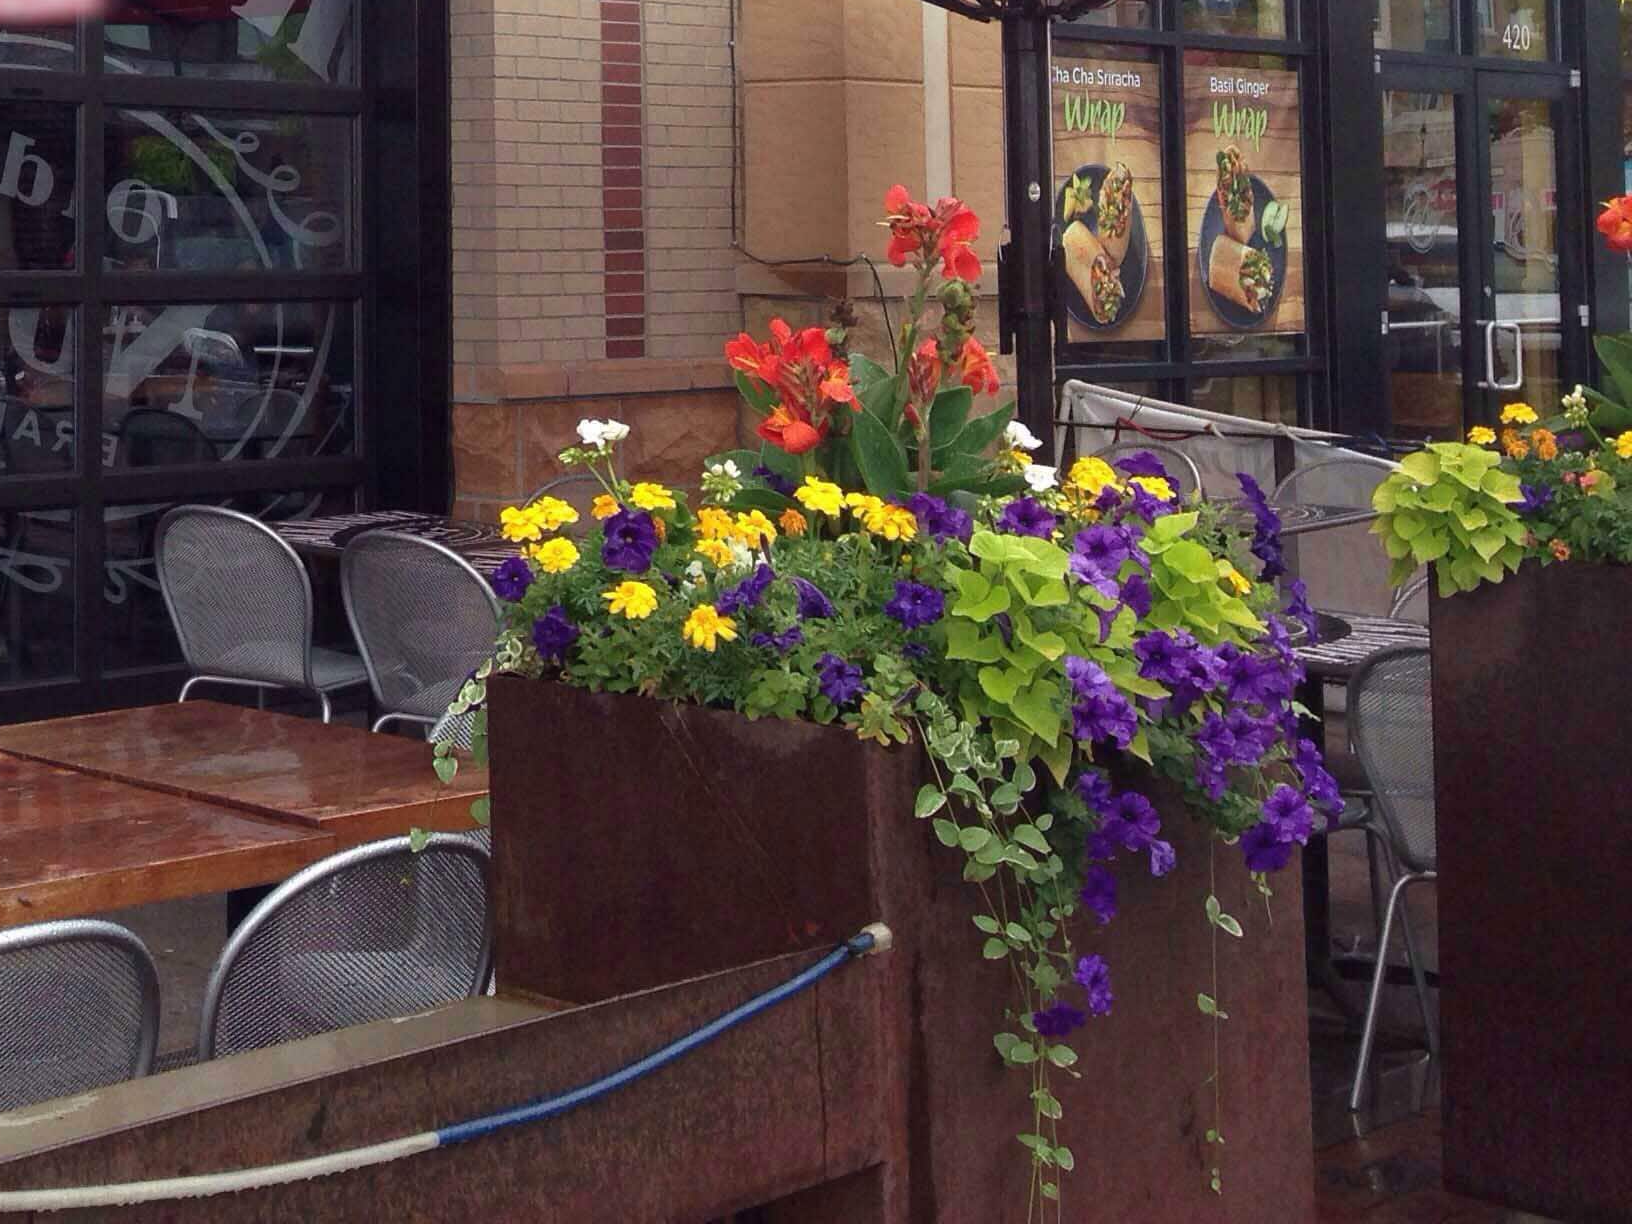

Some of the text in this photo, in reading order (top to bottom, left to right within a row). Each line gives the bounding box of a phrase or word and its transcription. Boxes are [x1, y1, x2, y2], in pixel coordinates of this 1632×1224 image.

[1502, 23, 1531, 51] 420
[1072, 67, 1095, 85] Cha
[1097, 70, 1142, 88] Sriracha
[1210, 76, 1270, 99] Basil Ginger
[1064, 87, 1126, 145] Wrap
[1213, 96, 1268, 153] Wrap
